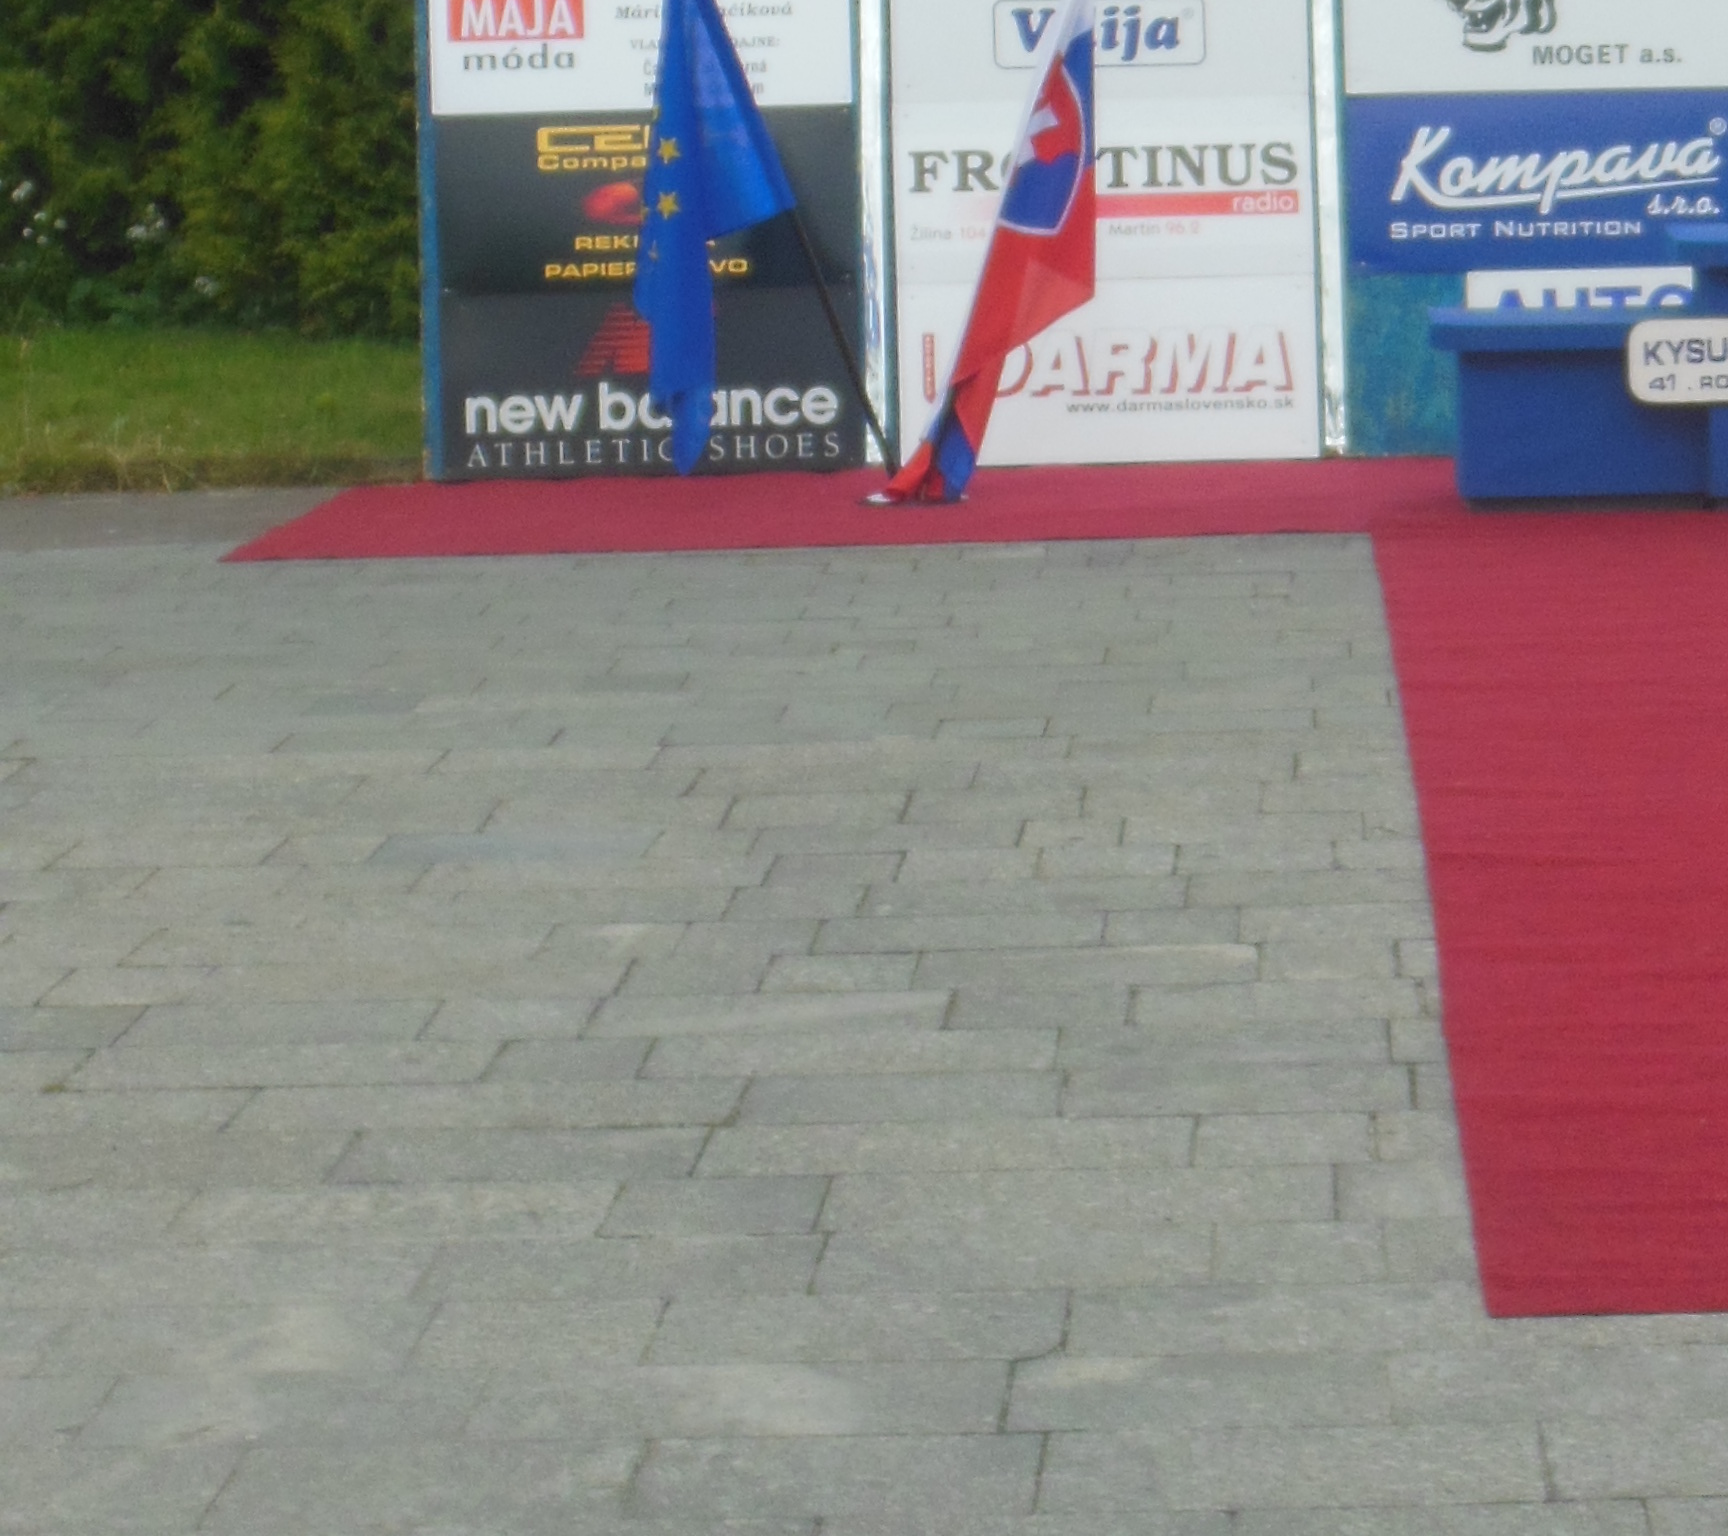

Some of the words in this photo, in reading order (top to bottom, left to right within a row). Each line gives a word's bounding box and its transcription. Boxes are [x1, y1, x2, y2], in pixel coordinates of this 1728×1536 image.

[615, 3, 660, 19] Mári
[1011, 4, 1180, 63] Vija
[462, 42, 576, 72] móda
[1532, 43, 1631, 66] MOGET
[1639, 45, 1684, 65] a.s.
[907, 141, 1298, 194] FRTINUS
[1391, 124, 1722, 215] Kompava
[1232, 191, 1294, 213] radio
[1646, 192, 1723, 217] s.r.o.
[1108, 221, 1161, 237] Martin
[465, 393, 583, 435] new
[1066, 395, 1295, 414] www.darmaslovensko.sk
[709, 431, 841, 462] SHOES
